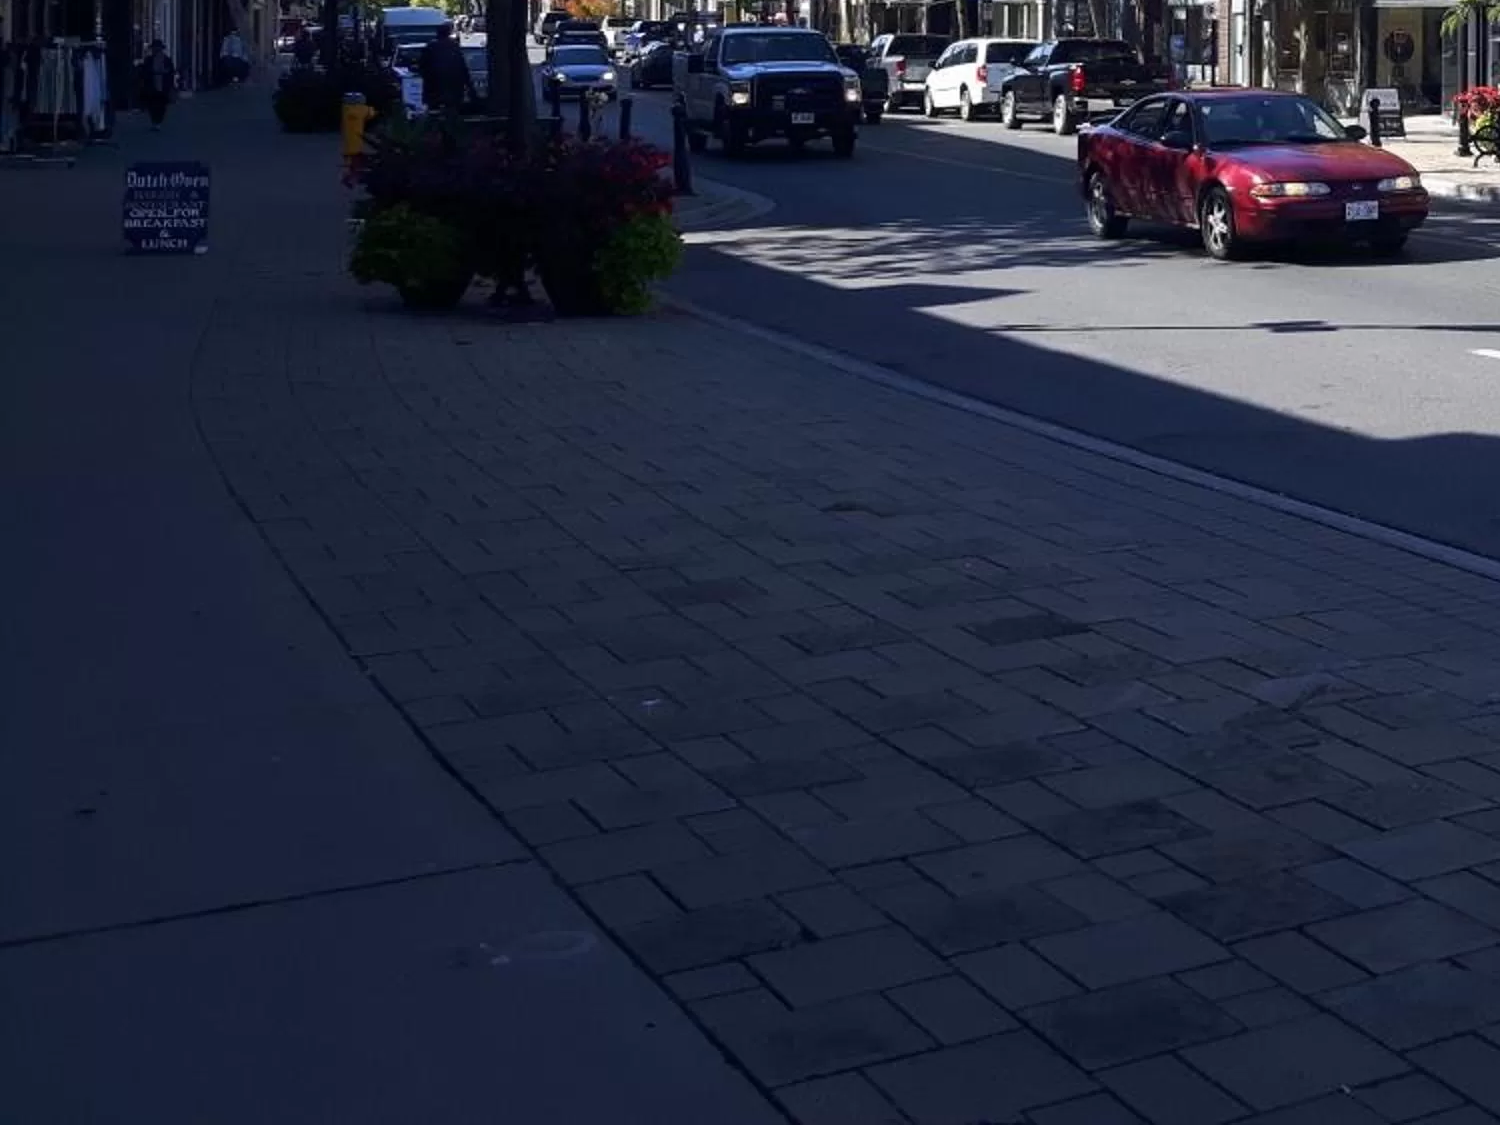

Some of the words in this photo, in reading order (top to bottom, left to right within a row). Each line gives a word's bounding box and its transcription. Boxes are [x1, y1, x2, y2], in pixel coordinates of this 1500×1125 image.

[129, 208, 169, 218] OPEN
[173, 208, 200, 218] FOR
[124, 218, 206, 228] BREAKFAST
[141, 238, 188, 249] LUNCH
